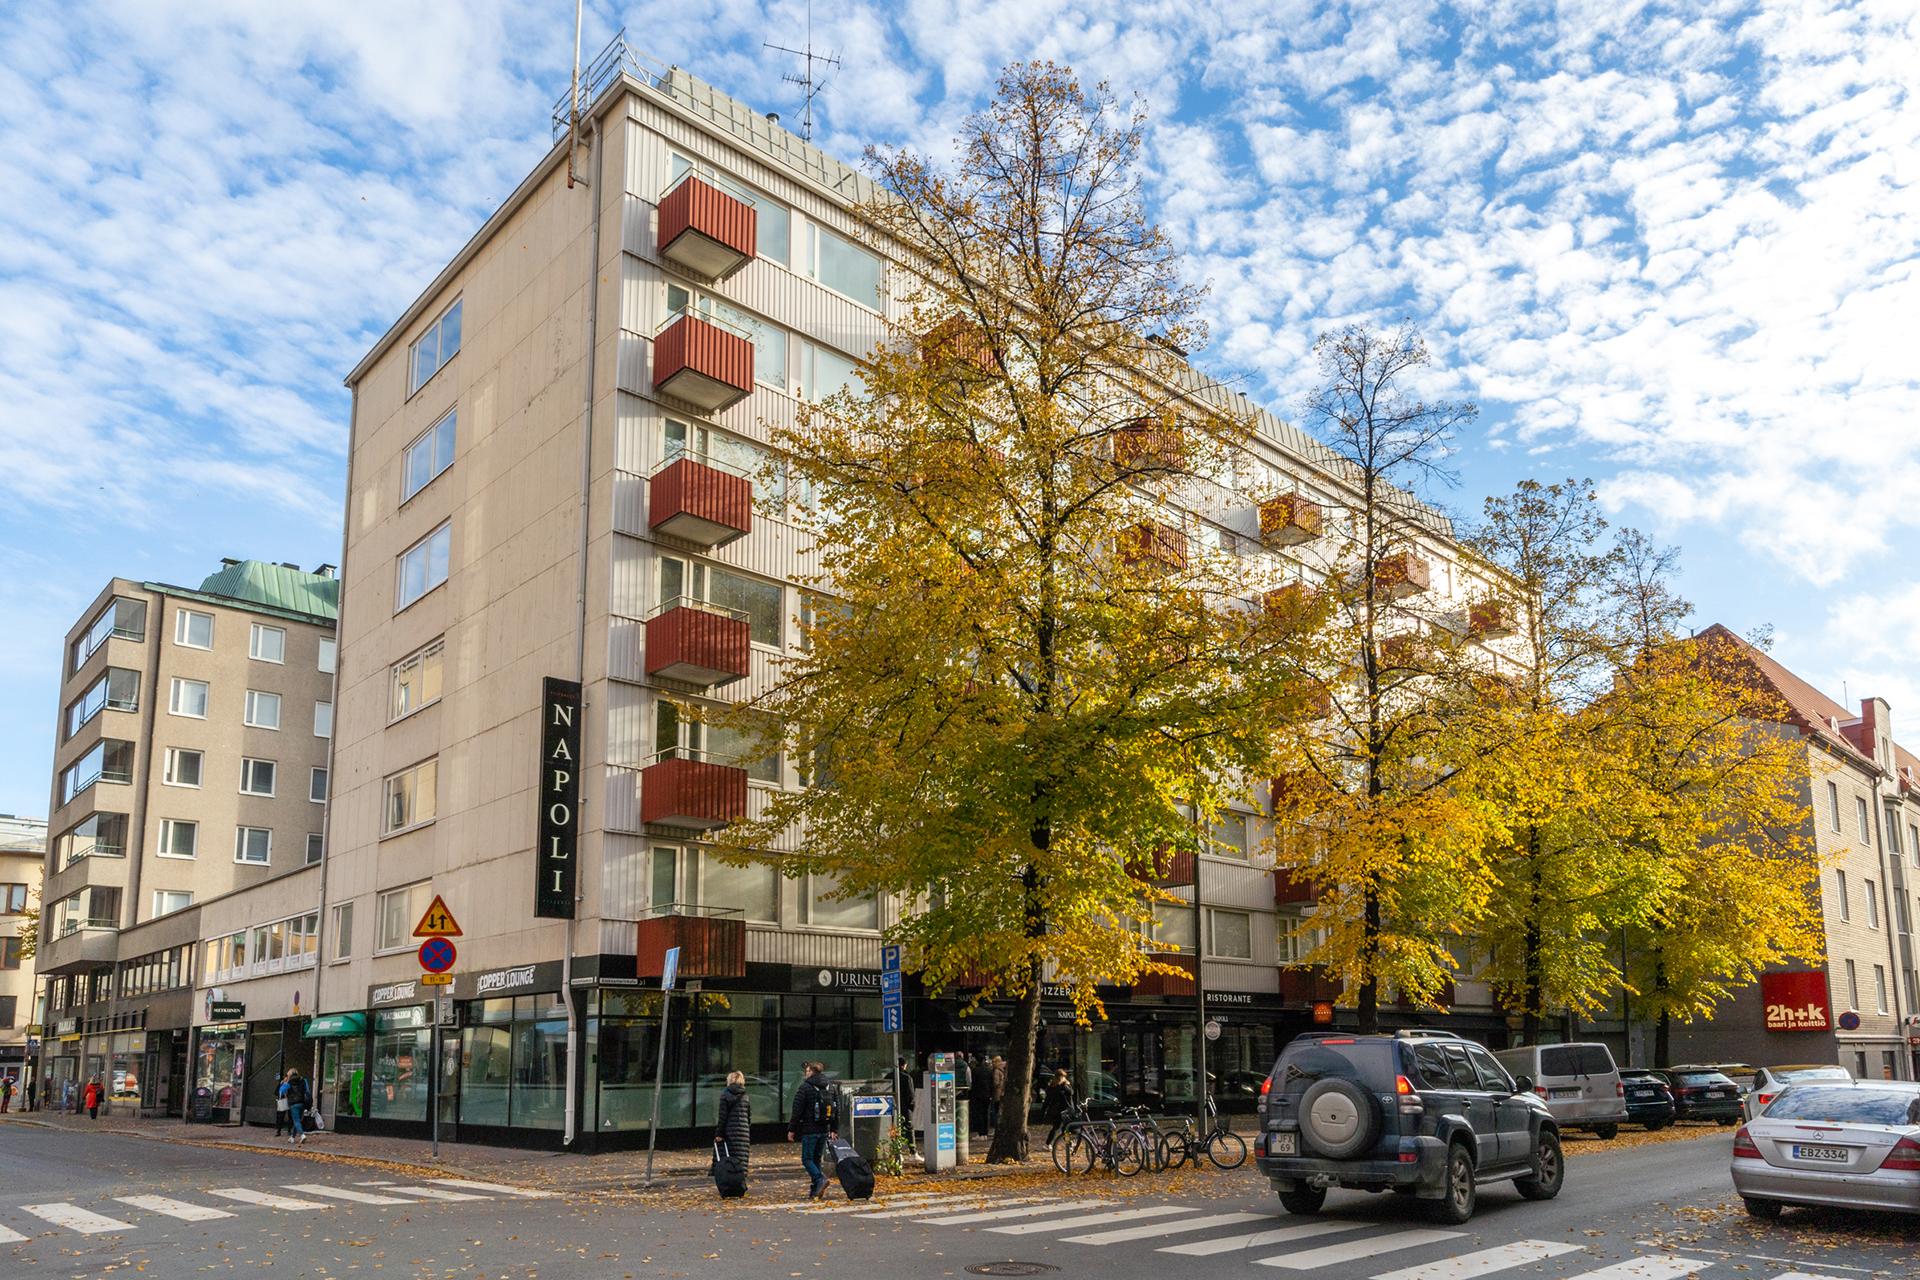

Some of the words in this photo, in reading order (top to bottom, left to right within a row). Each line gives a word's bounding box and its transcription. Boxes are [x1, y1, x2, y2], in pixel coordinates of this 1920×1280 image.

[550, 703, 574, 893] NAPOLI
[886, 948, 897, 970] P
[480, 972, 505, 991] COPPER
[506, 969, 535, 988] LOUNGE
[375, 986, 394, 1002] COPPER
[394, 983, 416, 1000] LOUNGE
[1206, 994, 1252, 1004] RISTORANTE
[1766, 1003, 1826, 1021] 2h+k
[1788, 1021, 1797, 1029] ja
[1797, 1019, 1827, 1027] keittiö
[1800, 1147, 1847, 1160] EBZ-334
